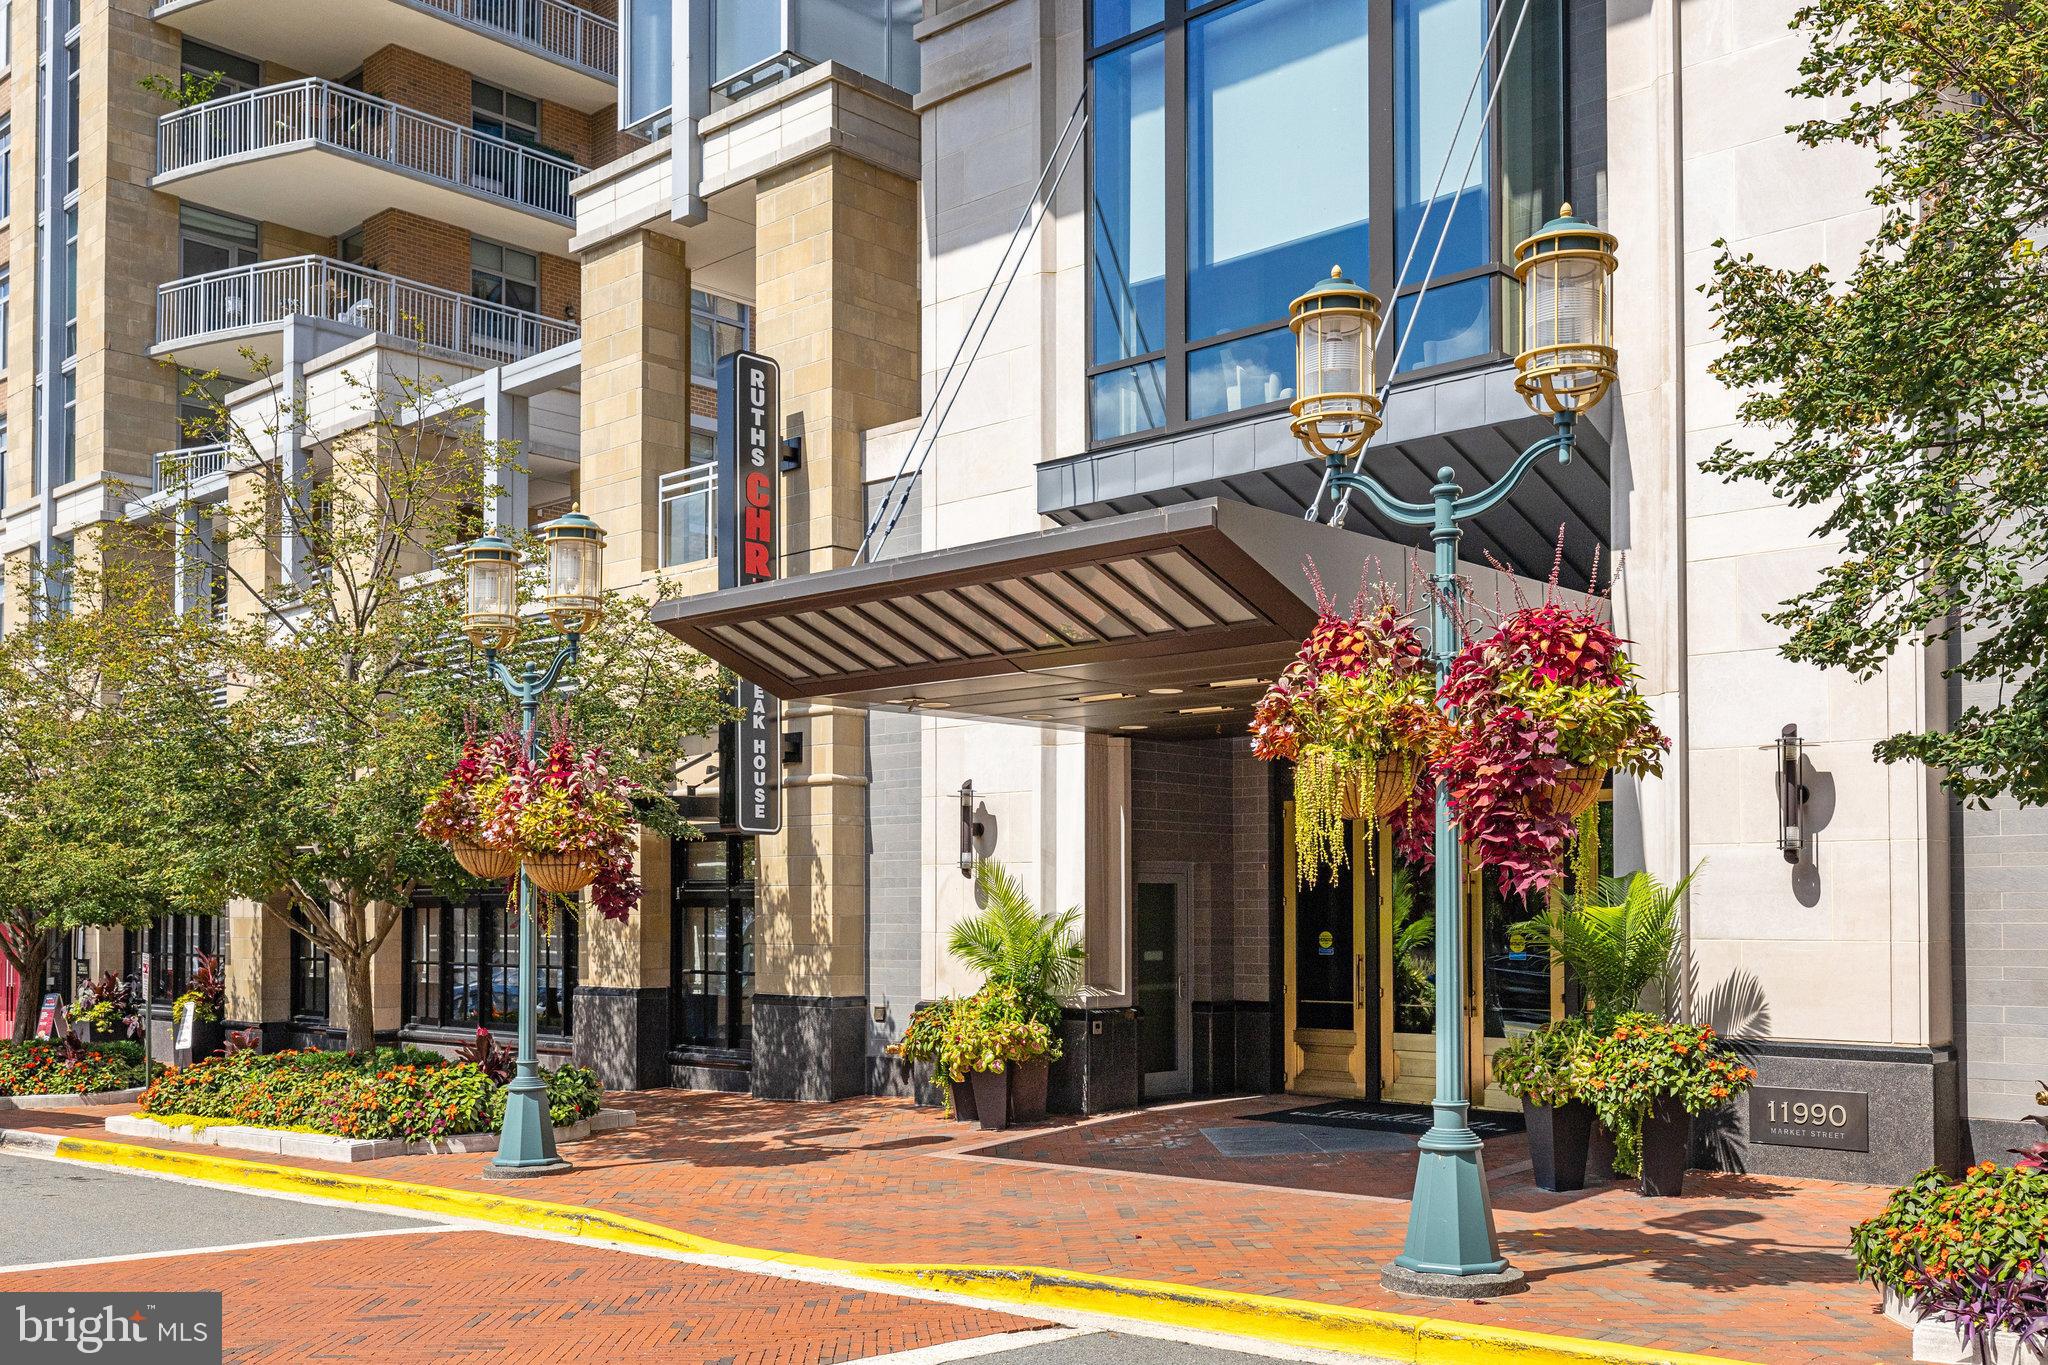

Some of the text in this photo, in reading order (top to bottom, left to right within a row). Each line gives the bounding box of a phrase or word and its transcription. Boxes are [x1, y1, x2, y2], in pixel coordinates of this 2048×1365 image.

[745, 368, 771, 819] RUTHS CHR EAK HOUSE
[1767, 1100, 1847, 1127] 11990
[1770, 1127, 1845, 1140] MARKET STREET
